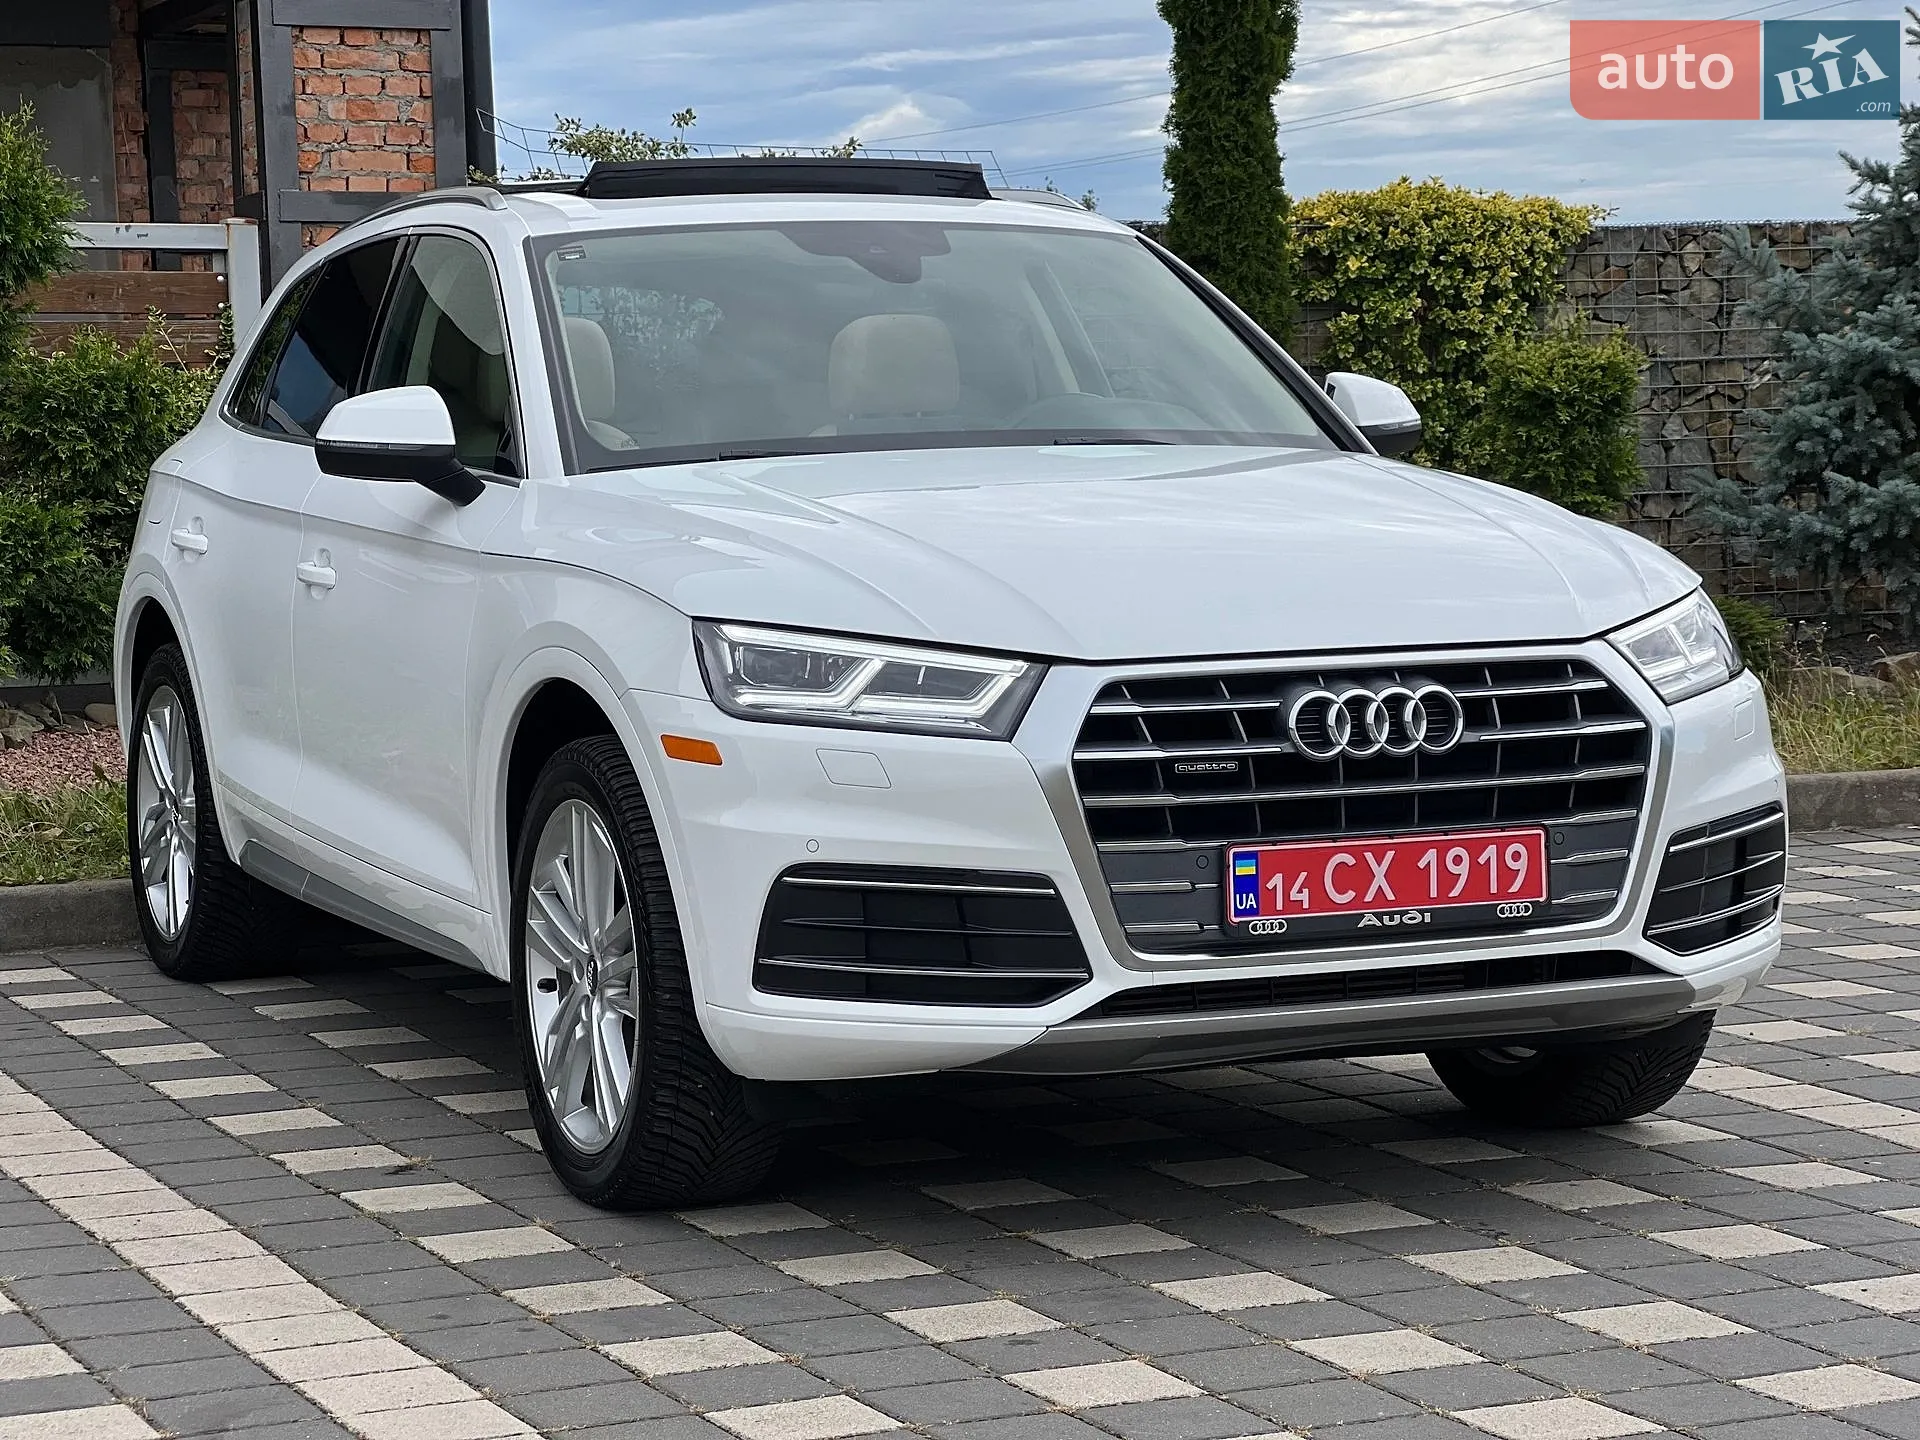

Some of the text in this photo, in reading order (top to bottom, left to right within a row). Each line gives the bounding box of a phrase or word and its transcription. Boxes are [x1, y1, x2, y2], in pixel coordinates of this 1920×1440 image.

[1178, 763, 1236, 772] quattro
[1265, 842, 1529, 911] 14 CX 1919
[1235, 892, 1258, 910] UA
[1357, 910, 1431, 928] Audi
